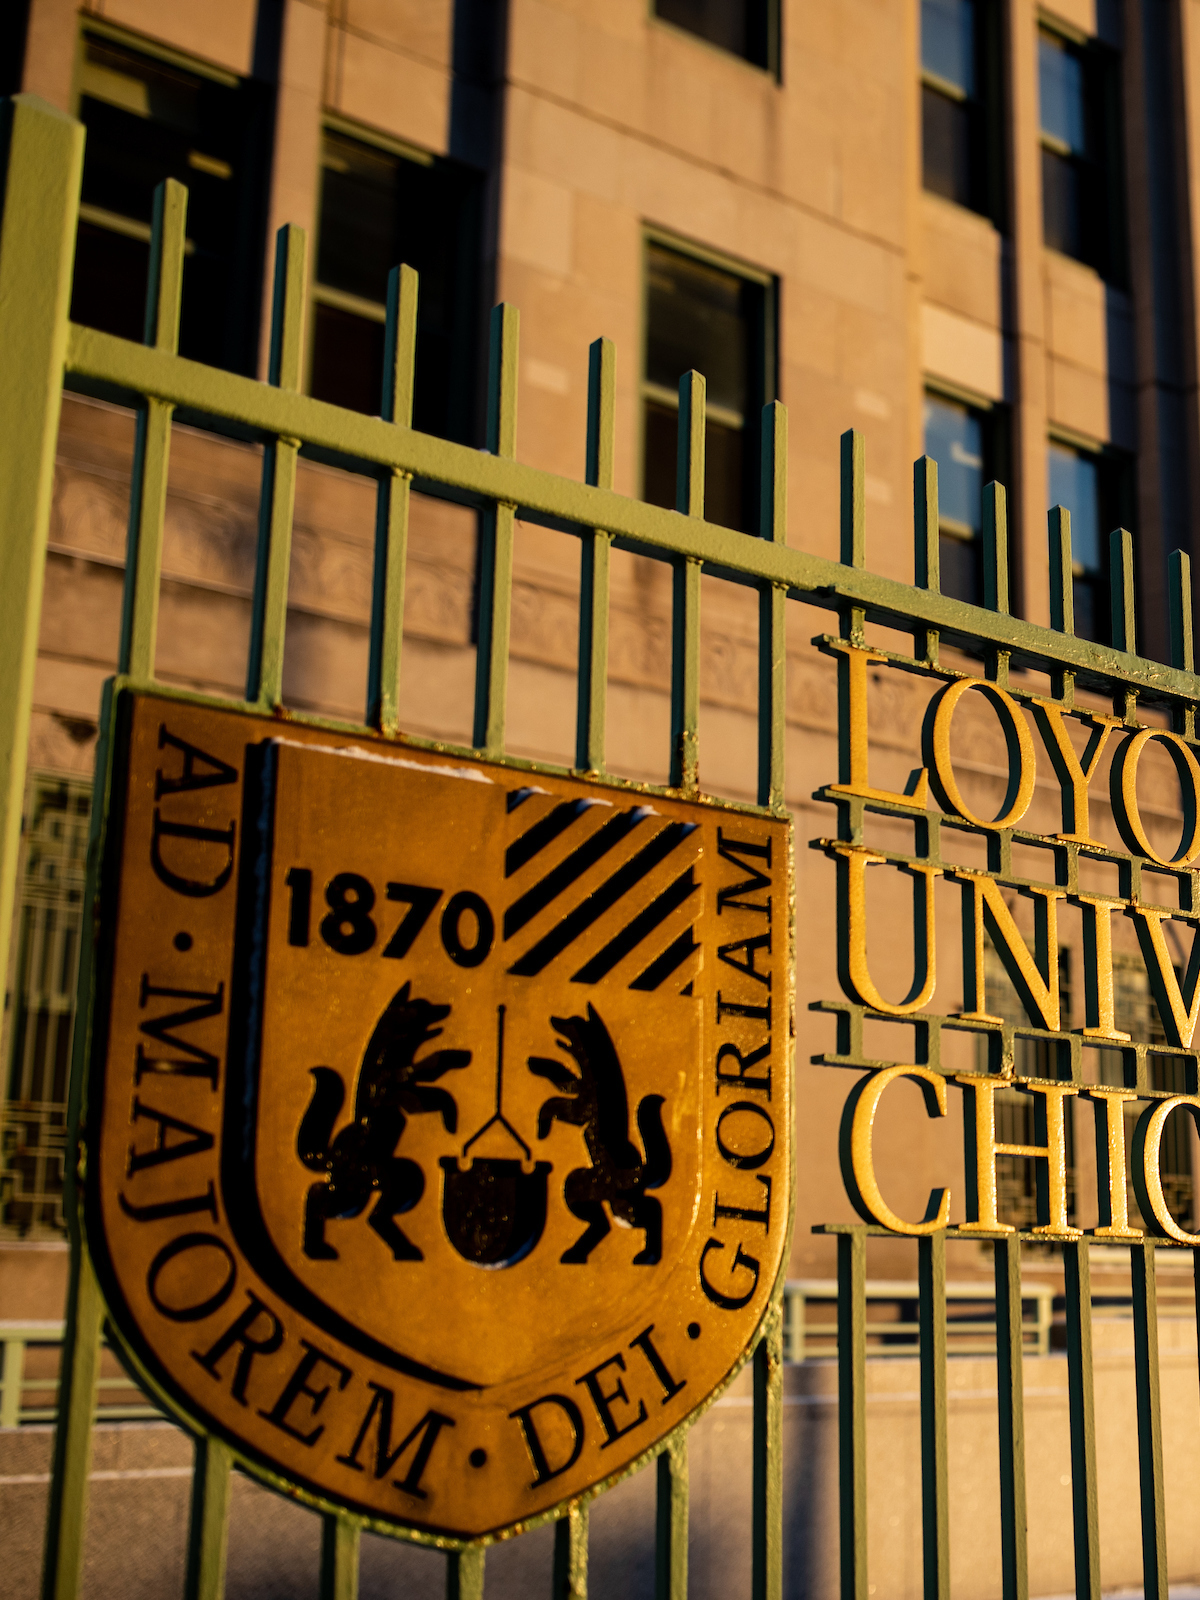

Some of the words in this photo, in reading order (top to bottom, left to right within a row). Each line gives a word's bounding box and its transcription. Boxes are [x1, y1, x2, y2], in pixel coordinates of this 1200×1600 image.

[150, 721, 238, 898] AD
[284, 866, 496, 969] 1870
[698, 827, 774, 1312] GLORIAM
[116, 971, 456, 1500] MAJOREM
[508, 1322, 688, 1490] DEI
